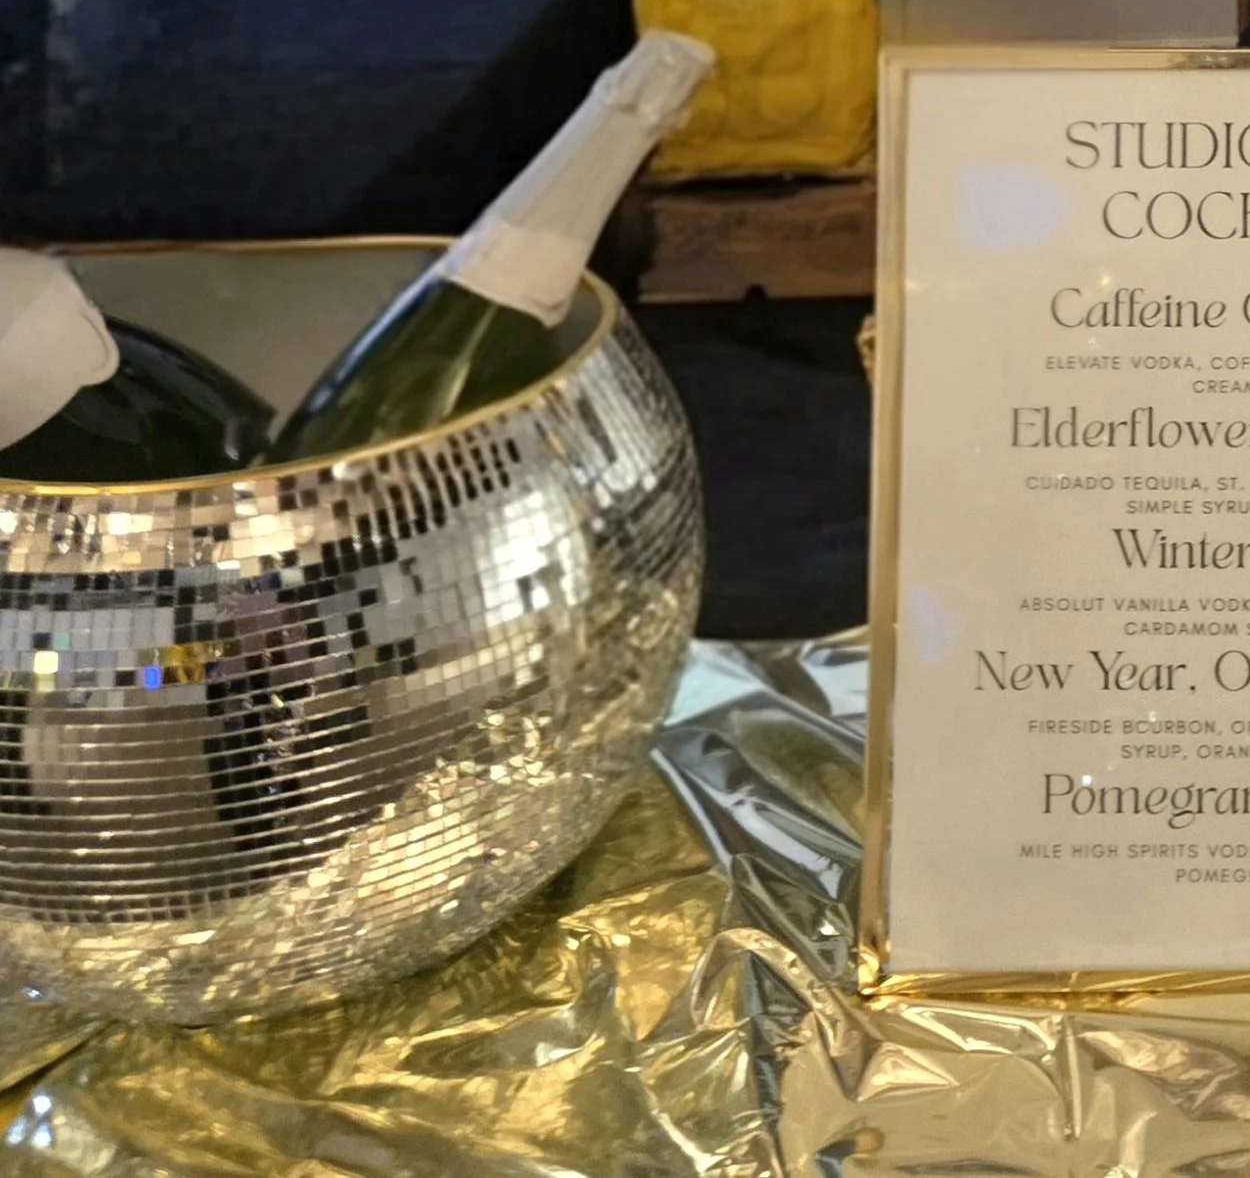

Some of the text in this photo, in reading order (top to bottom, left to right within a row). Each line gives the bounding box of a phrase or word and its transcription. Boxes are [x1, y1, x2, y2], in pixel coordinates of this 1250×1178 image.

[1049, 287, 1228, 329] Caffeine
[1044, 354, 1122, 372] ELEVATE
[1129, 355, 1203, 373] VODKA,
[1024, 474, 1116, 492] CUIDADO
[1121, 475, 1210, 494] TEQUILA,
[1215, 475, 1246, 492] ST.
[1124, 499, 1194, 516] SIMPLE
[1017, 596, 1106, 614] ABSOLUT
[1111, 597, 1191, 613] VANILLA
[1122, 620, 1240, 637] CARDAMOM
[974, 649, 1075, 692] New
[1087, 649, 1197, 695] Year,
[1026, 718, 1113, 736] FIRESIDE
[1120, 743, 1189, 761] SYRUP,
[1017, 842, 1063, 860] MILE
[1070, 842, 1120, 860] HIGH
[1126, 843, 1200, 860] SPIRITS
